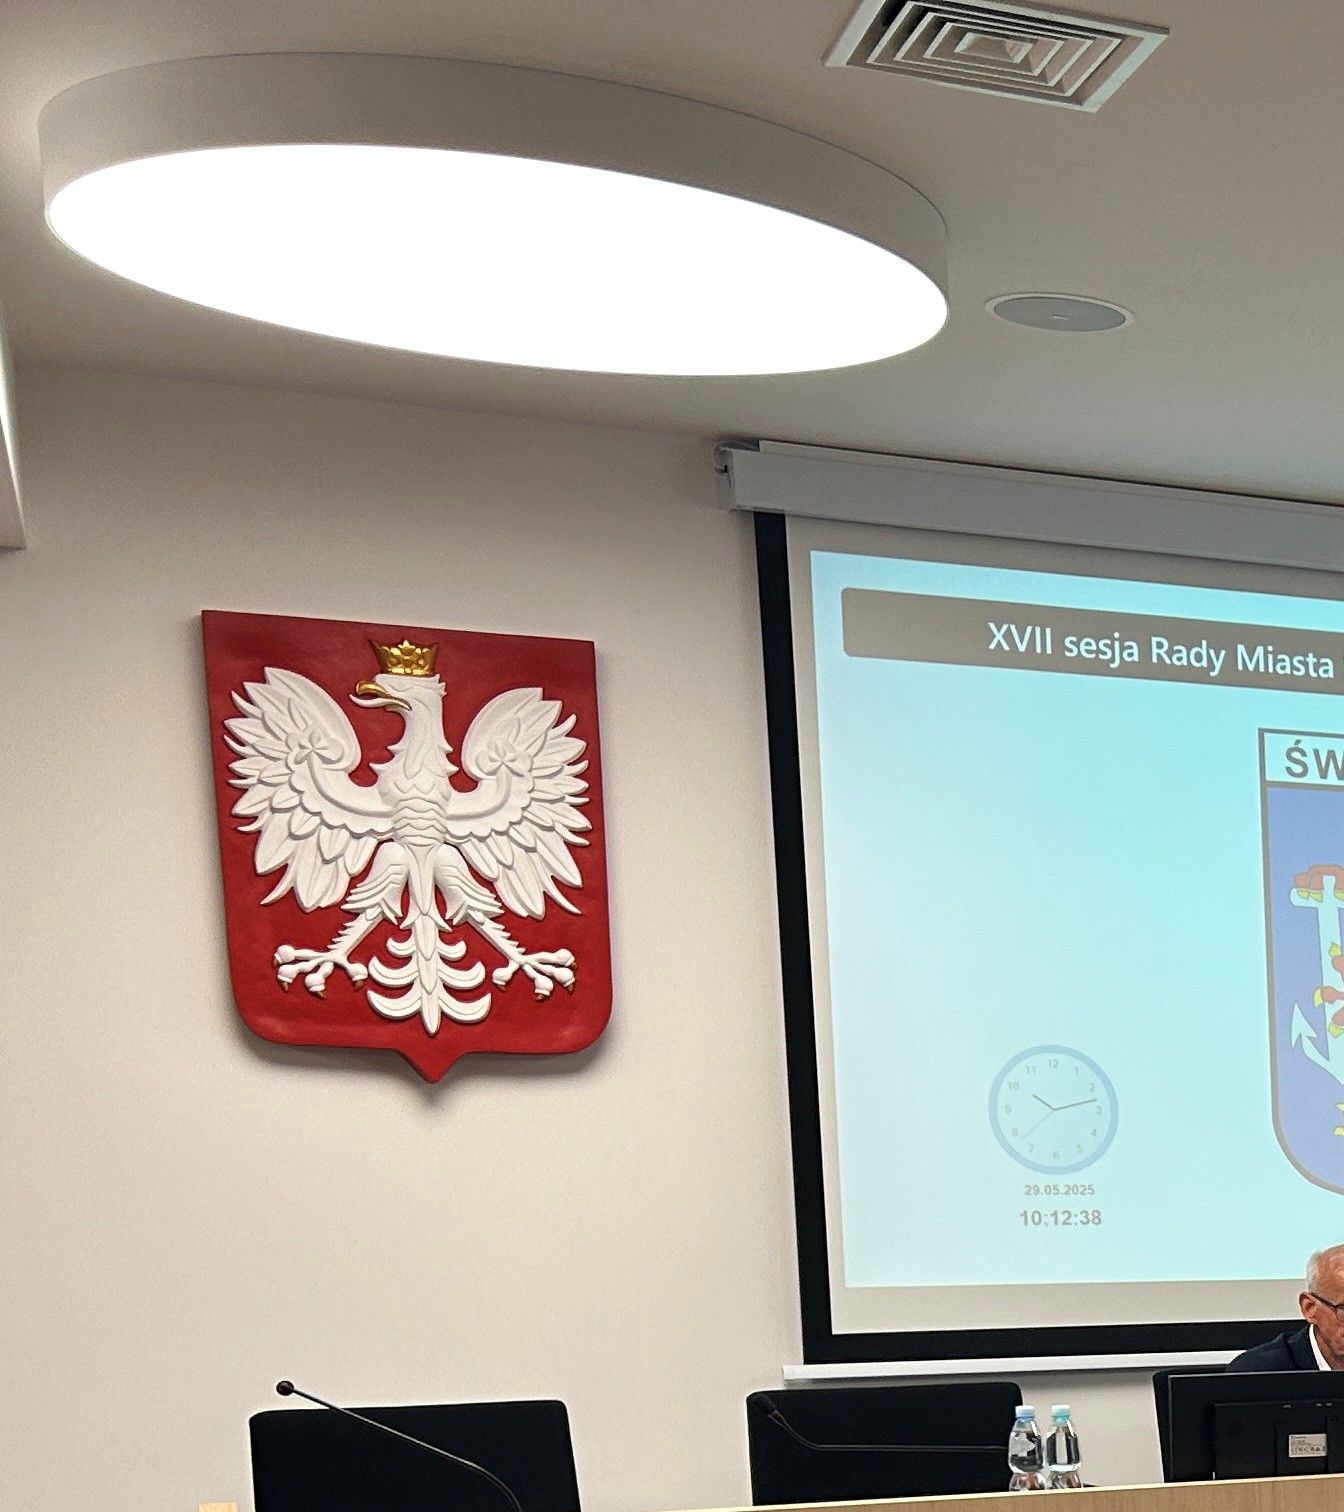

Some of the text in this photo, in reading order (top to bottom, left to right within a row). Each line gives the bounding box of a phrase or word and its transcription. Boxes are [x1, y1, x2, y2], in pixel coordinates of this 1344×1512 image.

[987, 622, 1053, 655] XVII
[1064, 632, 1140, 668] sesja
[1150, 636, 1226, 677] Rady
[1236, 643, 1334, 679] Miasta
[1024, 1184, 1095, 1196] 29.05.2025
[1020, 1210, 1102, 1226] 10:12:38
